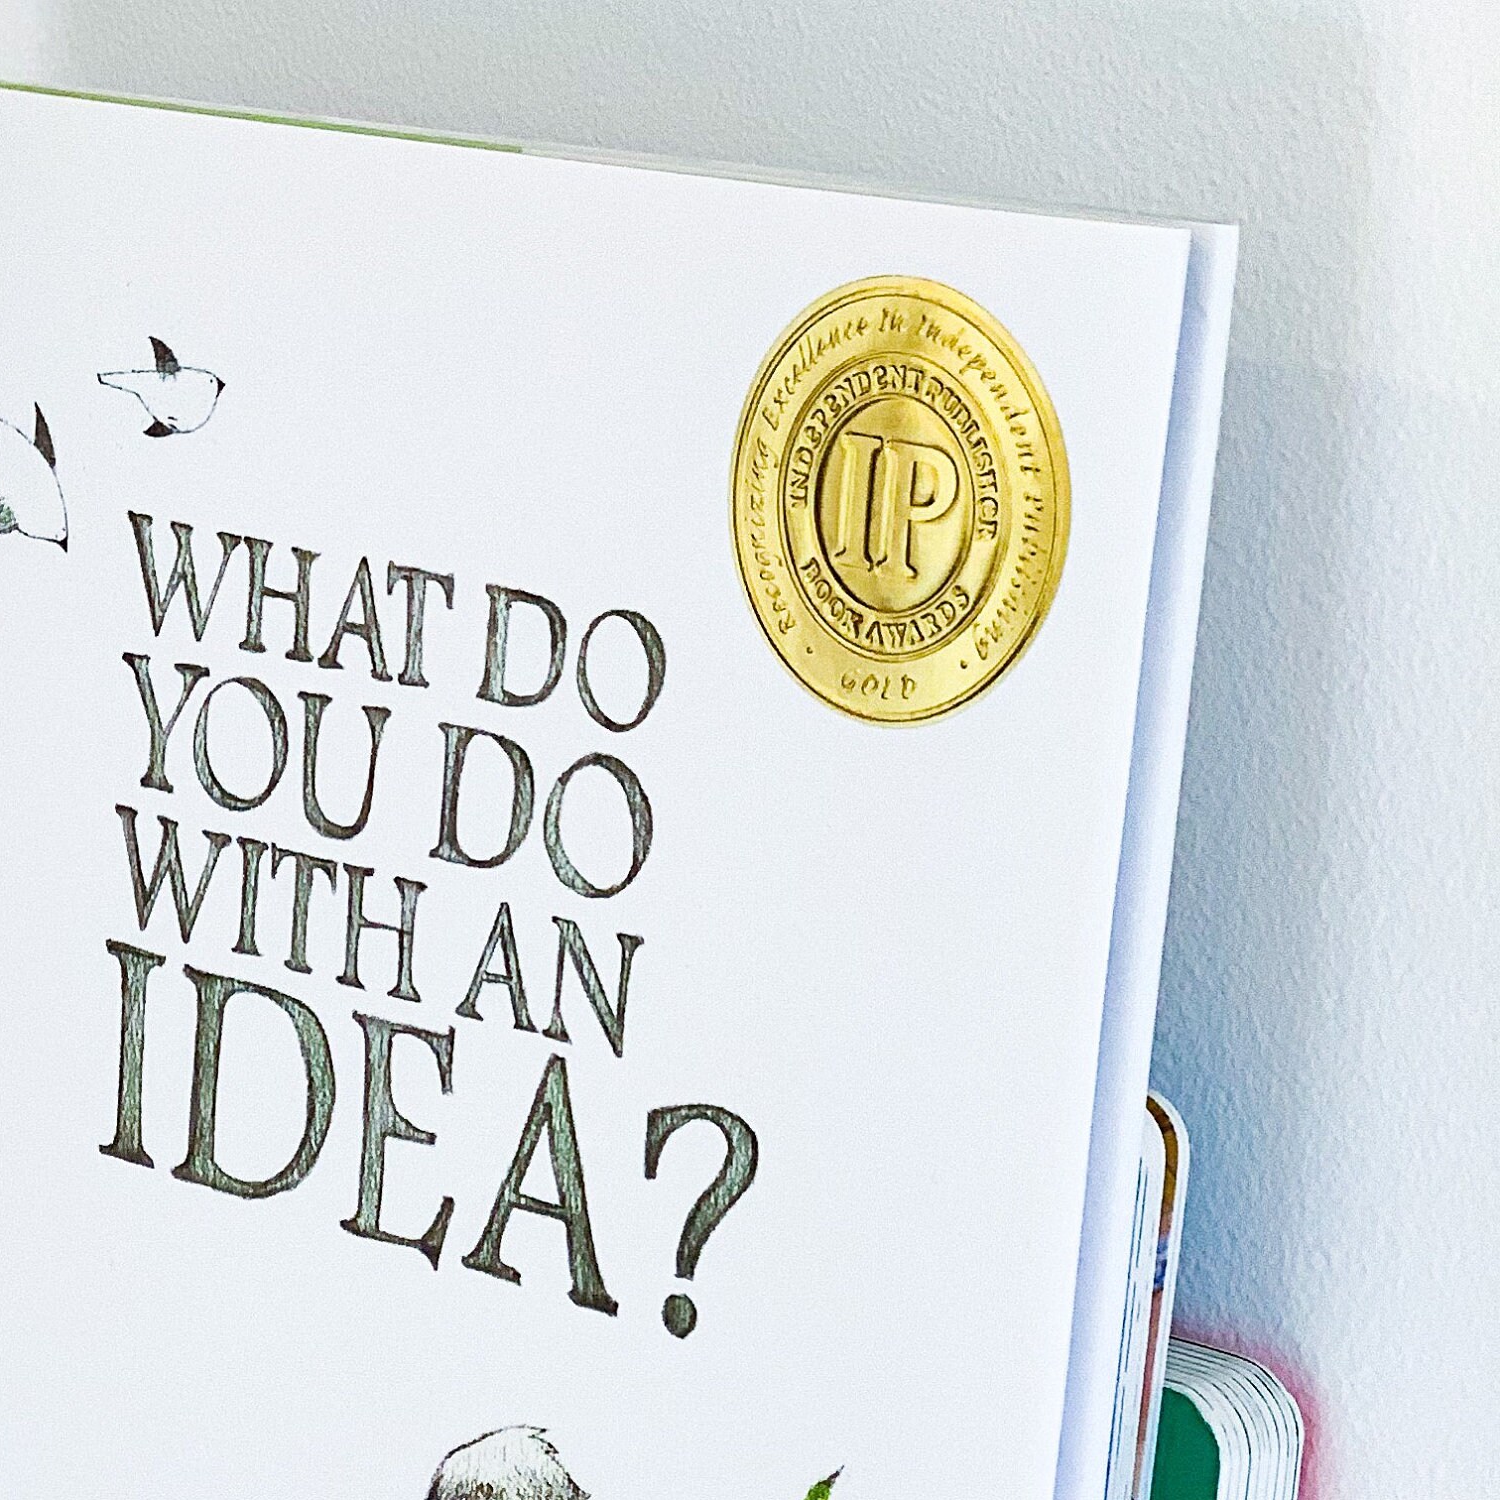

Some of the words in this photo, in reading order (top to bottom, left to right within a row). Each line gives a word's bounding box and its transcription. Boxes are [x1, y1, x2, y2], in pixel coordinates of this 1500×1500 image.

[761, 315, 868, 432] Excellence
[789, 363, 926, 508] INDEPENDENT
[924, 374, 1001, 543] PUBLISHER
[833, 432, 960, 580] IP
[127, 510, 455, 688] WHAT
[476, 583, 667, 733] DO
[800, 556, 864, 640] BOOK
[865, 584, 970, 649] AWARDS
[840, 672, 917, 701] GOLD
[122, 652, 391, 840] YOU
[428, 721, 654, 899] DO
[115, 803, 428, 1003] WITH
[455, 902, 645, 1058] AN
[99, 938, 760, 1339] IDEA?
